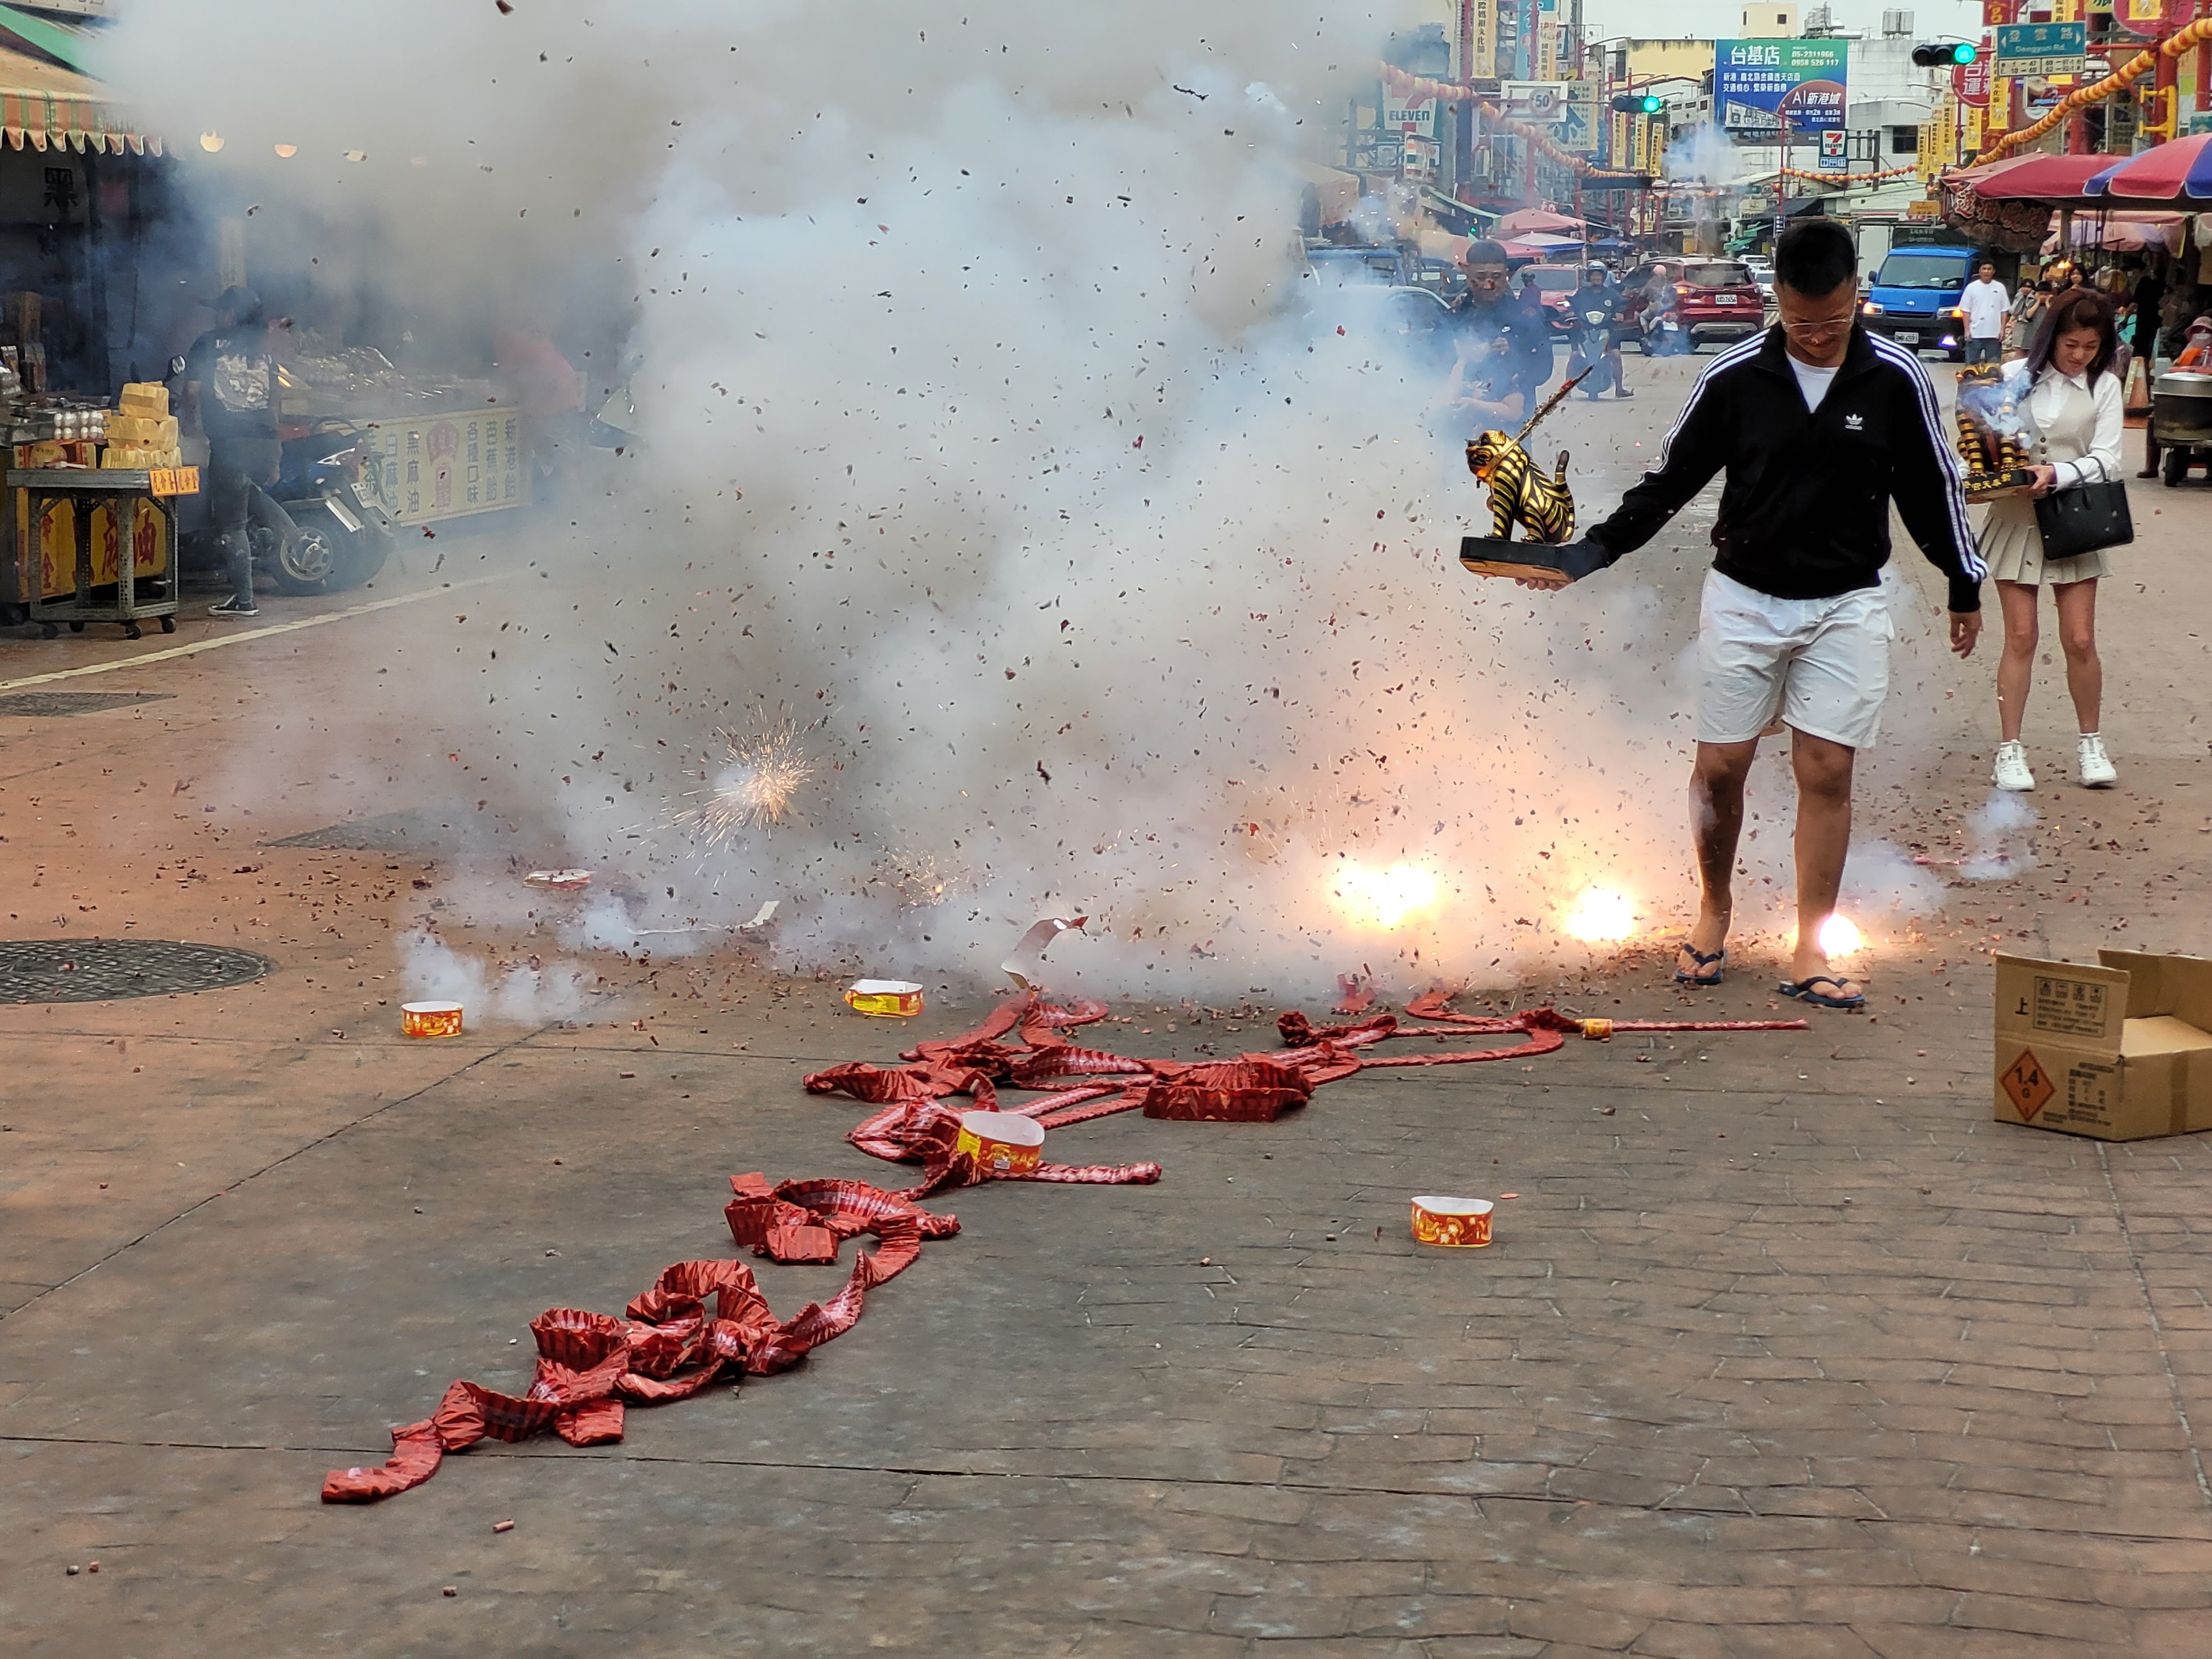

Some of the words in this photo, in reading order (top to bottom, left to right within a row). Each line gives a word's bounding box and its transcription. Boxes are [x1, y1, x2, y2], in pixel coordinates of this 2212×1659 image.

[1477, 0, 1486, 53] 際媽祖文化節
[1731, 45, 1780, 65] 台基店
[1536, 95, 1549, 107] 50
[2015, 997, 2029, 1015] 上
[2015, 1066, 2039, 1087] 1.4
